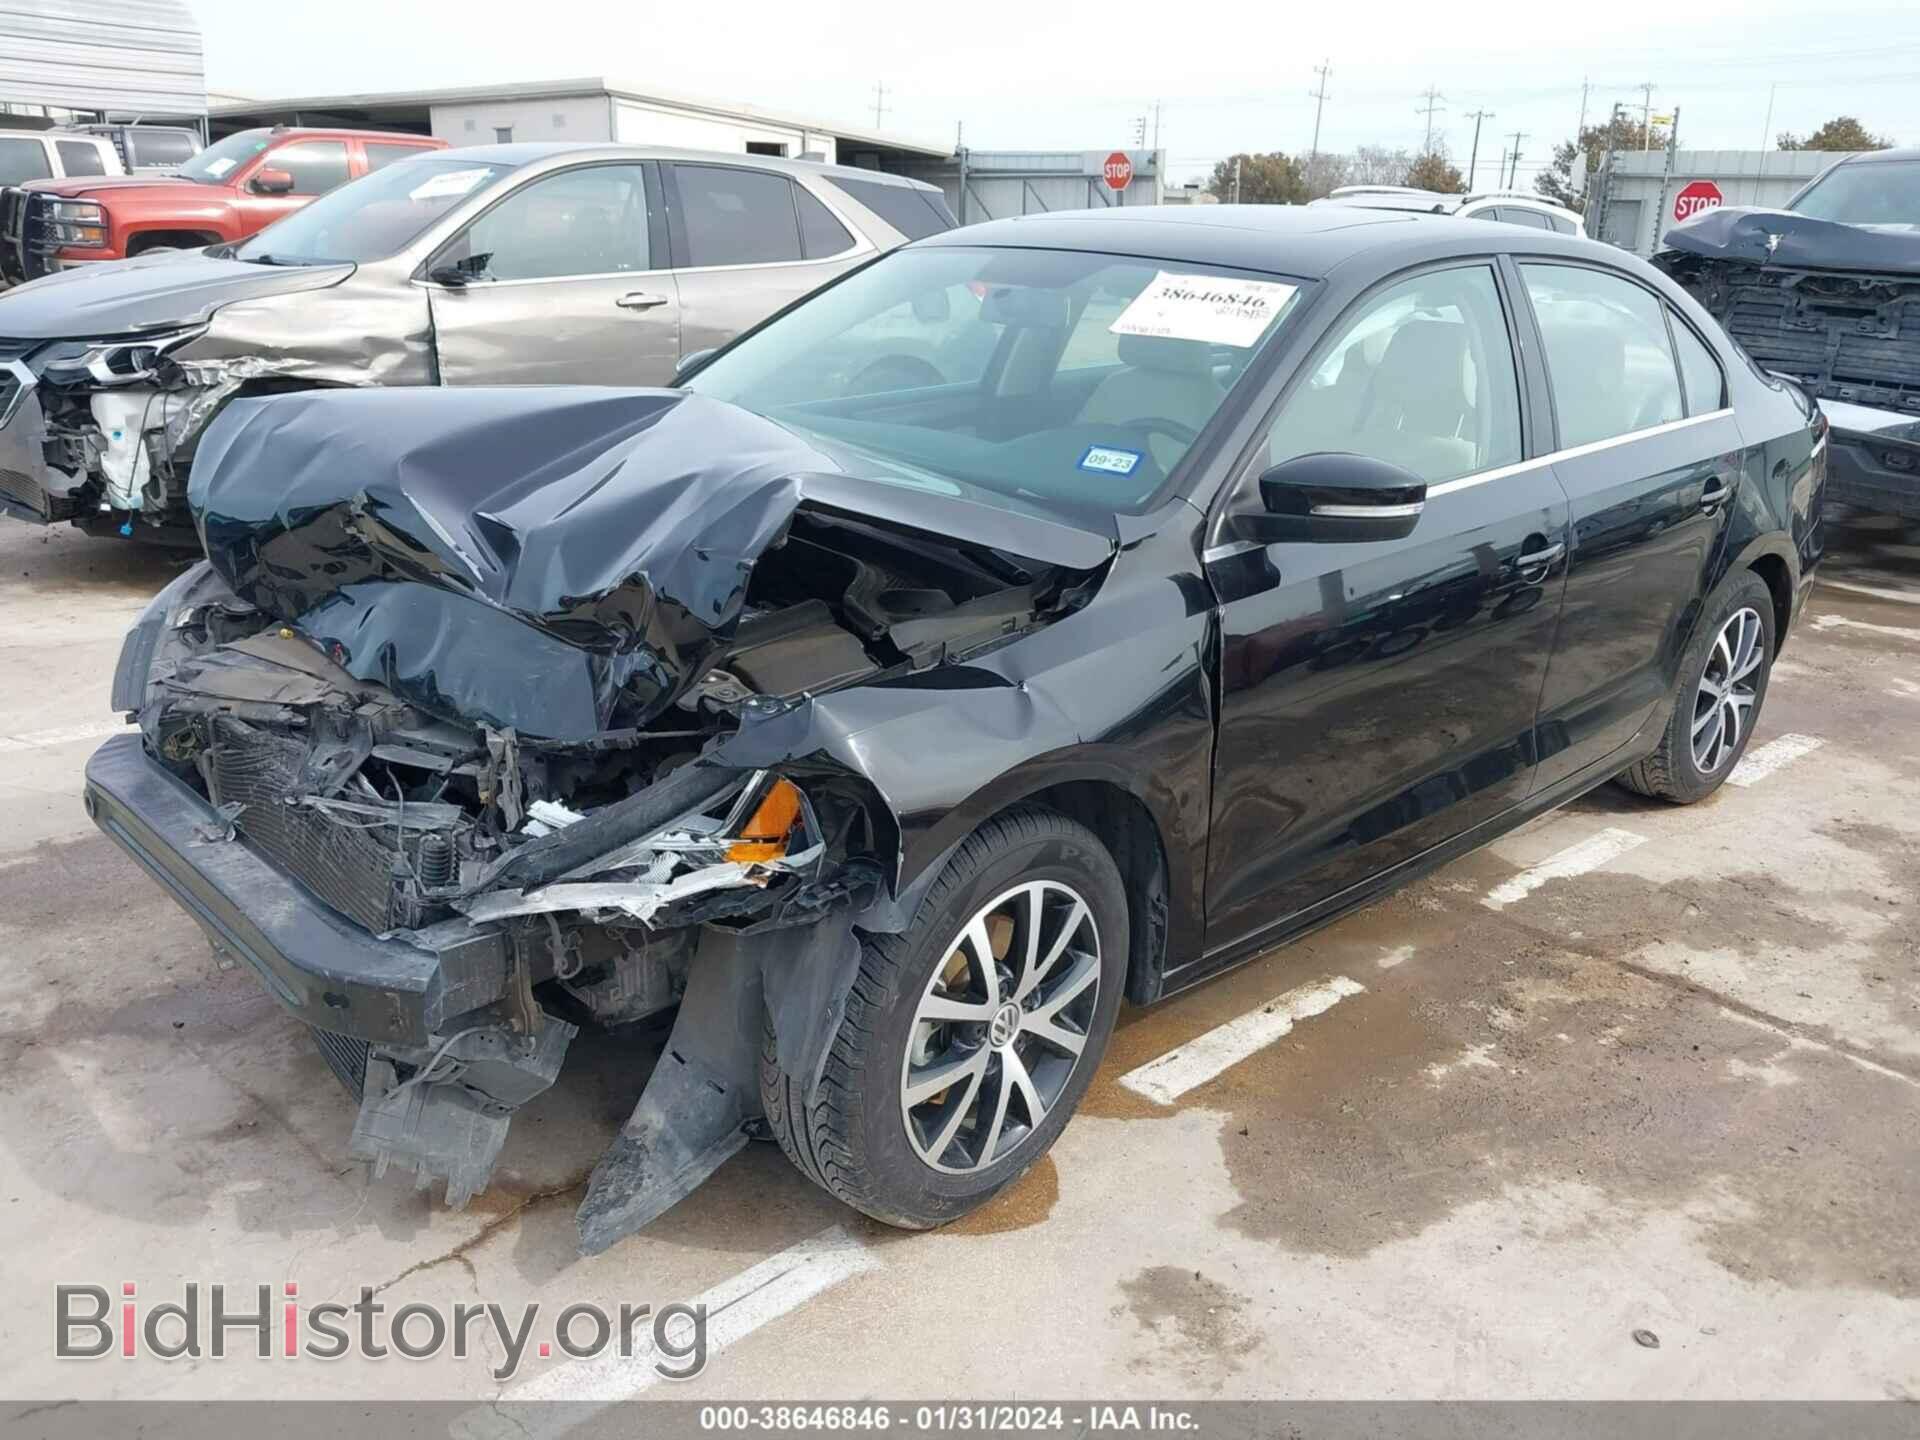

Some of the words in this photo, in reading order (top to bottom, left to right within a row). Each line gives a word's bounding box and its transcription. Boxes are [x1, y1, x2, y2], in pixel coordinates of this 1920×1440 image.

[1105, 163, 1130, 178] STOP
[1677, 197, 1720, 215] STOP
[1162, 287, 1266, 308] 38646846
